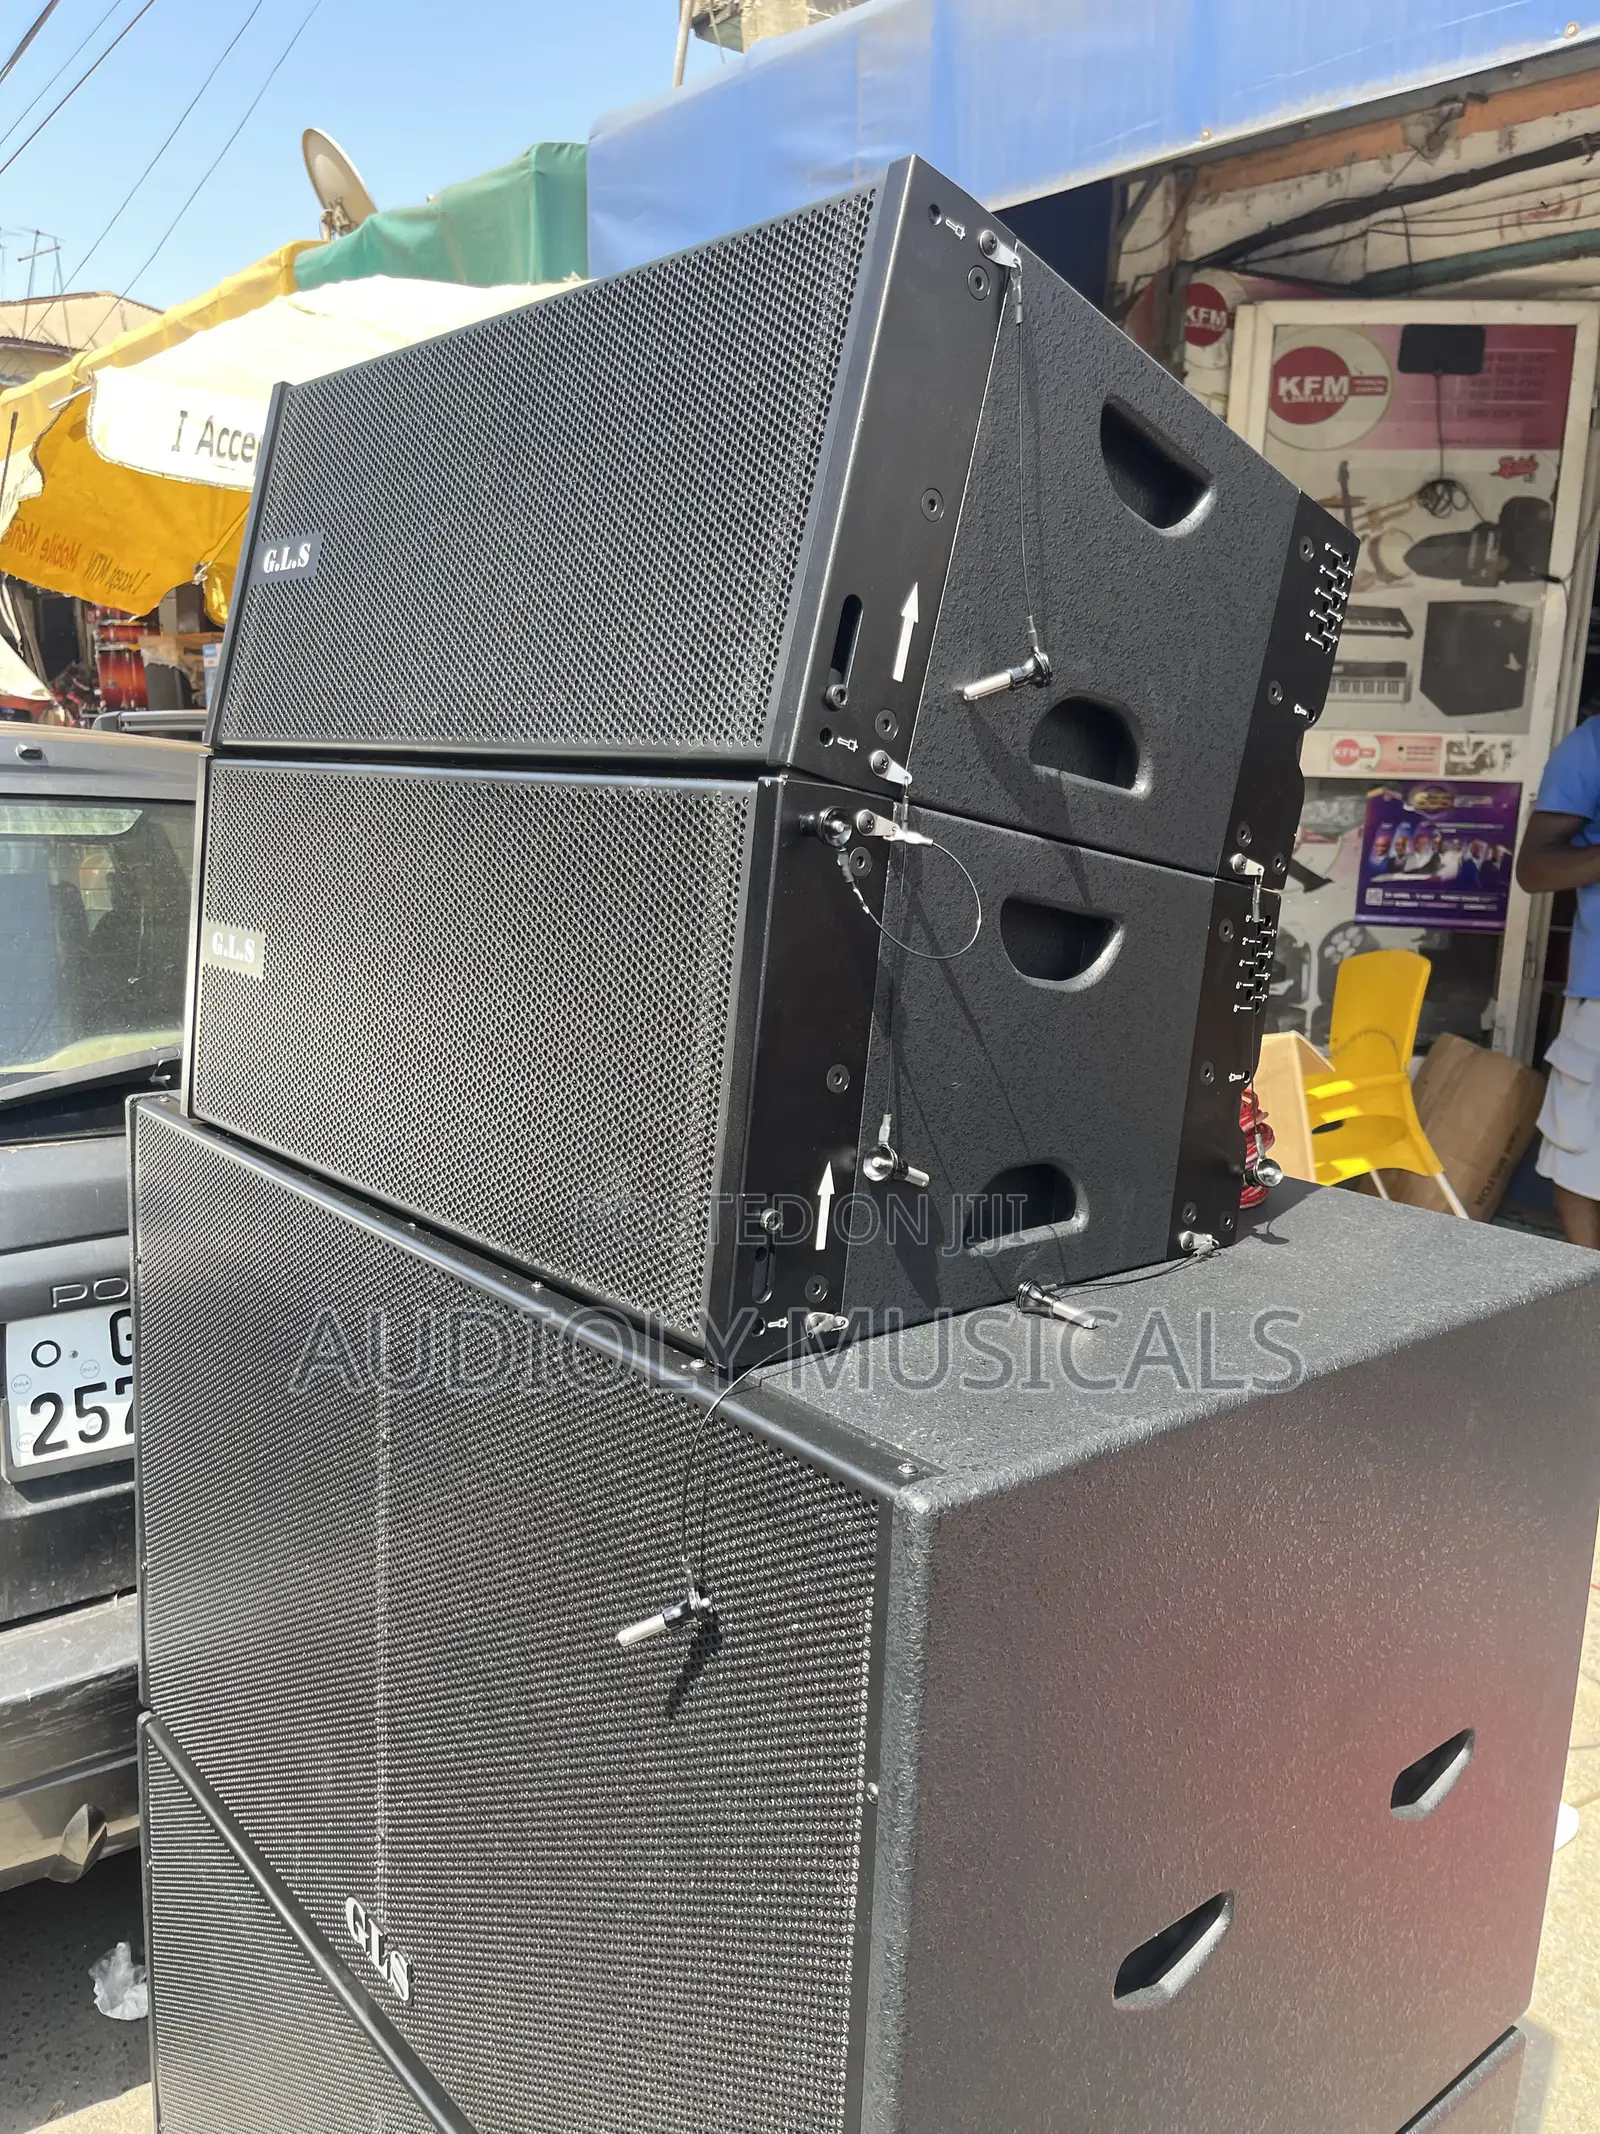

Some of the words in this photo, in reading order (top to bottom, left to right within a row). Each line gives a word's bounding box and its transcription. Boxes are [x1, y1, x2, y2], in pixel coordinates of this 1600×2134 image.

[1277, 375, 1349, 397] KFM
[171, 410, 188, 452] I
[263, 542, 311, 574] G.L.S
